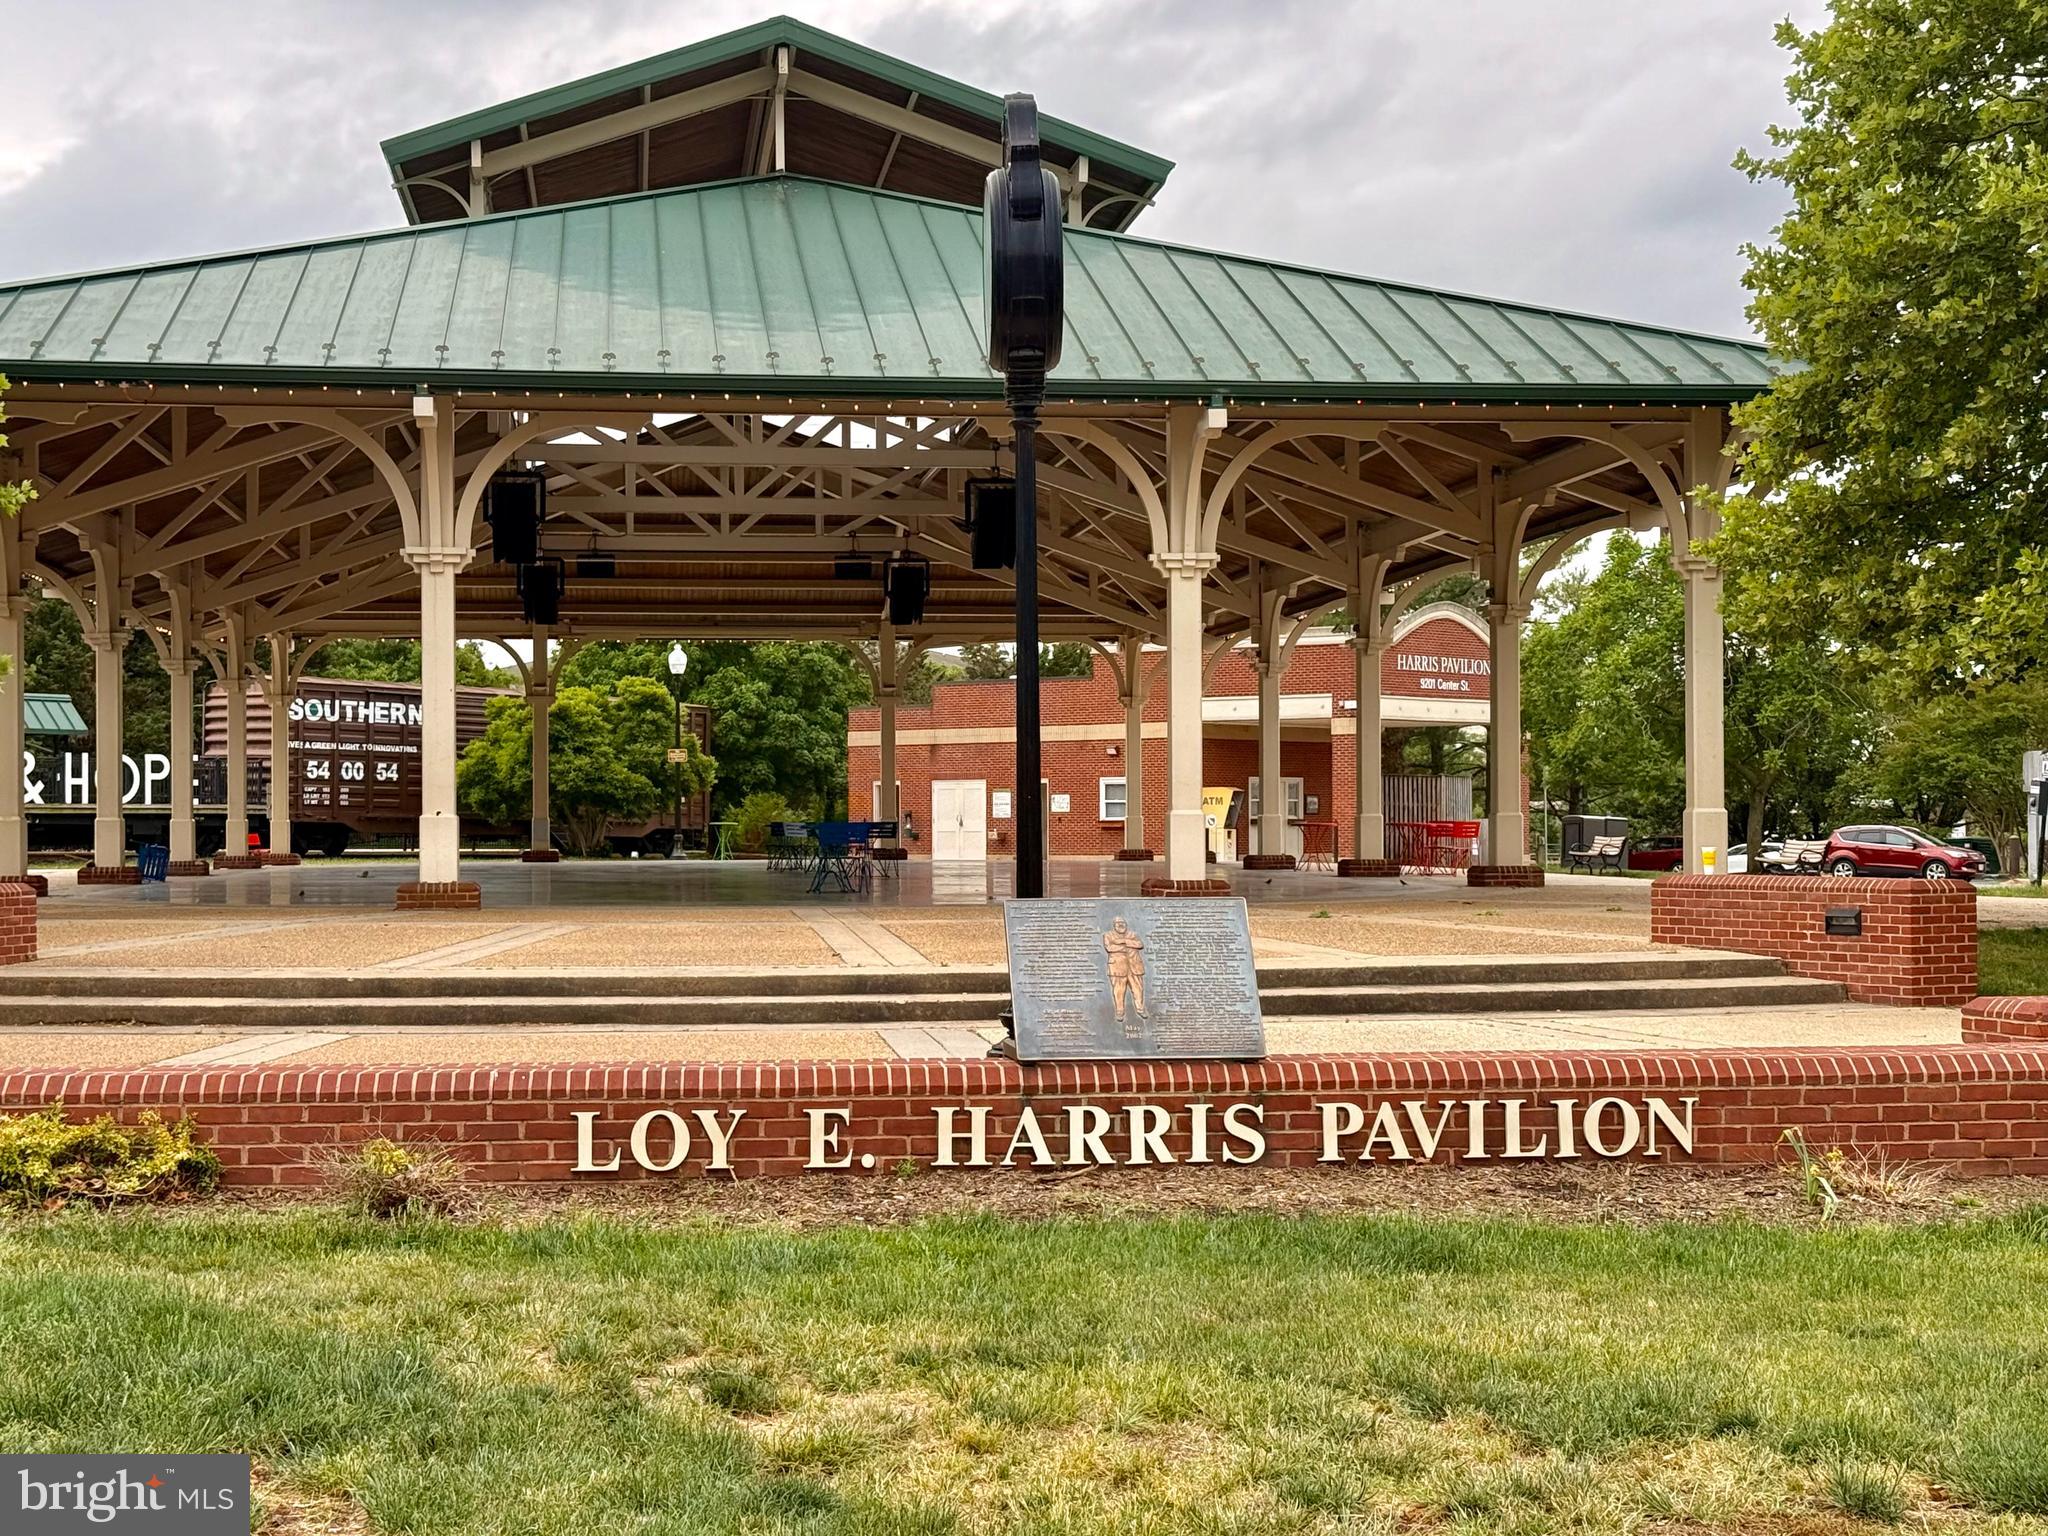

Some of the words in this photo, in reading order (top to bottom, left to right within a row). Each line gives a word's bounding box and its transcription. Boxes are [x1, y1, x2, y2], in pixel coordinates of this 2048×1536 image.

[1397, 654, 1438, 672] HARRIS
[1441, 657, 1490, 675] PAVILION
[1420, 678, 1435, 689] 9201
[1437, 678, 1459, 690] Center
[288, 697, 423, 725] SOUTHERN
[304, 741, 311, 749] A
[311, 741, 337, 750] GREEN
[338, 742, 360, 751] LIGHT
[362, 743, 372, 751] TO
[306, 760, 330, 779] 54
[341, 761, 364, 780] 00
[376, 762, 398, 781] 54
[1203, 797, 1223, 805] ATM
[570, 1109, 748, 1172] LOY
[803, 1107, 876, 1169] E.
[930, 1103, 1266, 1167] HARRIS
[1314, 1097, 1700, 1162] PAVILION
